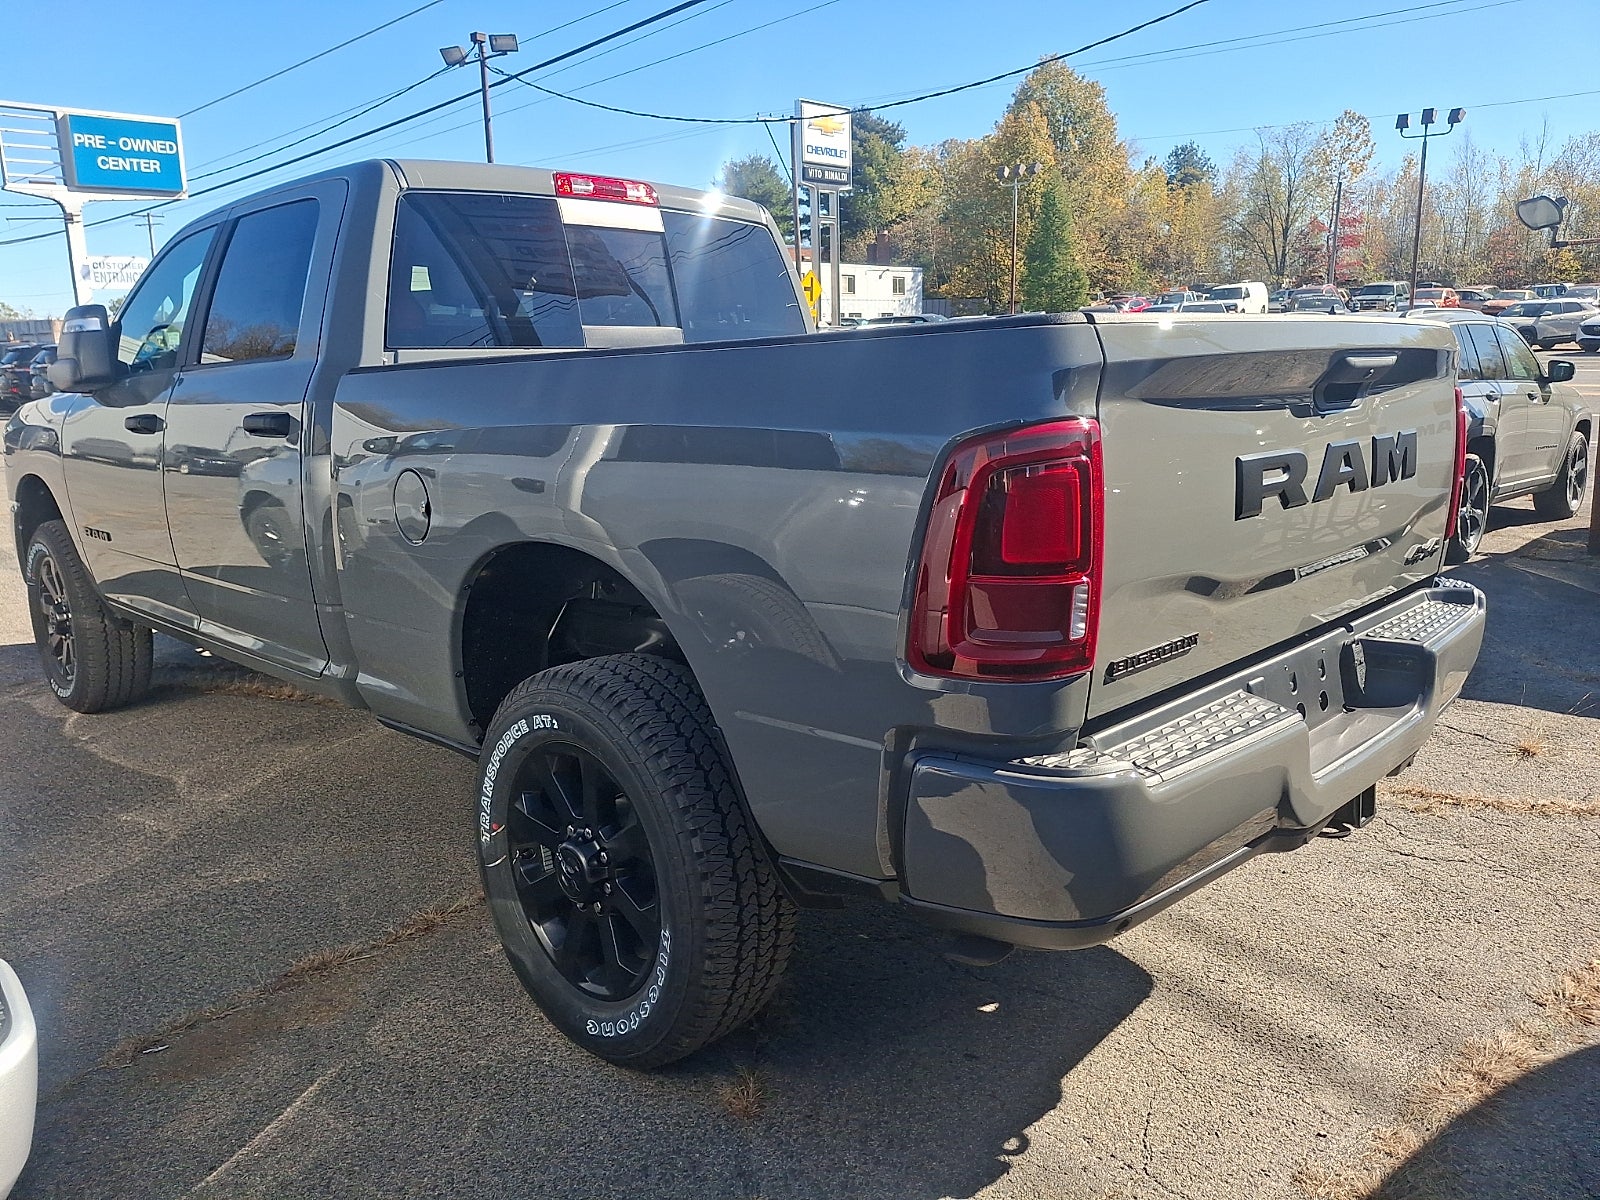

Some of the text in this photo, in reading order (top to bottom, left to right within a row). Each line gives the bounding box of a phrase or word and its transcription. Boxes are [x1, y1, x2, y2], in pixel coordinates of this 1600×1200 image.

[807, 145, 847, 158] CHEVROLET
[97, 156, 161, 173] CENTER
[808, 168, 848, 181] VITO RINALDI
[92, 260, 145, 270] CUSTOMER
[93, 271, 140, 283] ENTRANC
[1234, 427, 1418, 522] RAM
[84, 526, 111, 542] RAM
[480, 719, 530, 844] TRANSFORCE
